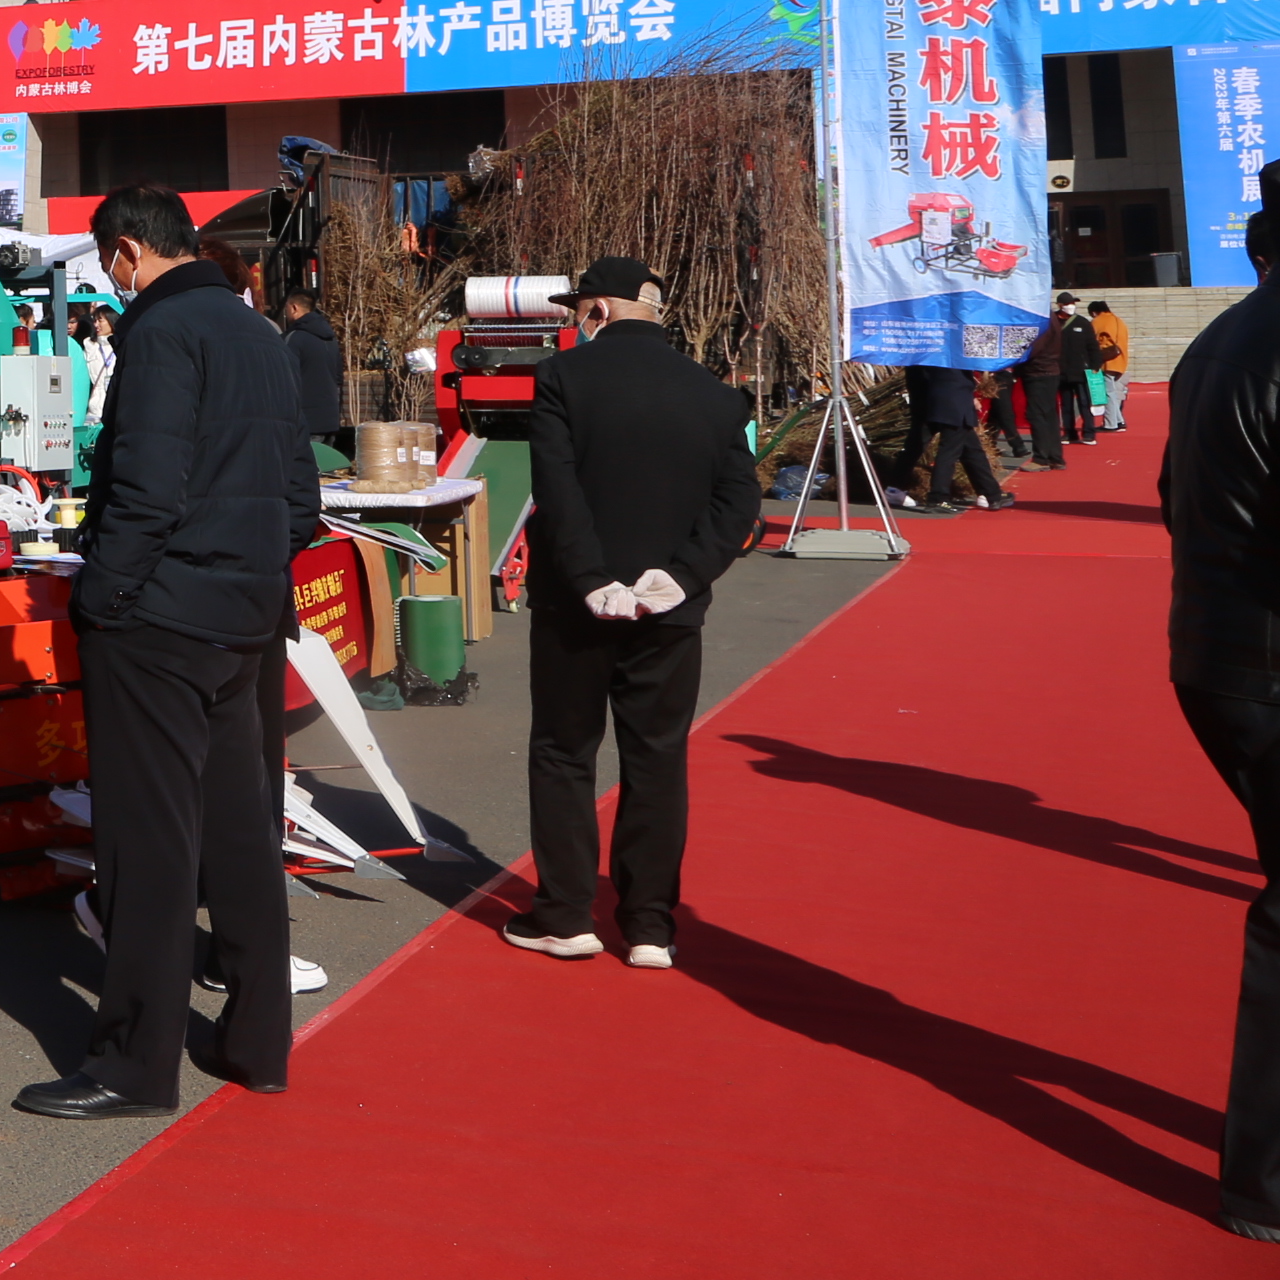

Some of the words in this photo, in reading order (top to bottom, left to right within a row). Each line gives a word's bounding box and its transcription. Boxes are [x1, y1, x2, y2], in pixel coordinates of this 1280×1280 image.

[15, 64, 95, 78] EXPOFORESTRY
[15, 80, 92, 97] 内蒙古林博会
[1213, 67, 1234, 151] 2023年第六届
[886, 51, 910, 176] MACHINERY
[1231, 66, 1266, 202] 春季农机展
